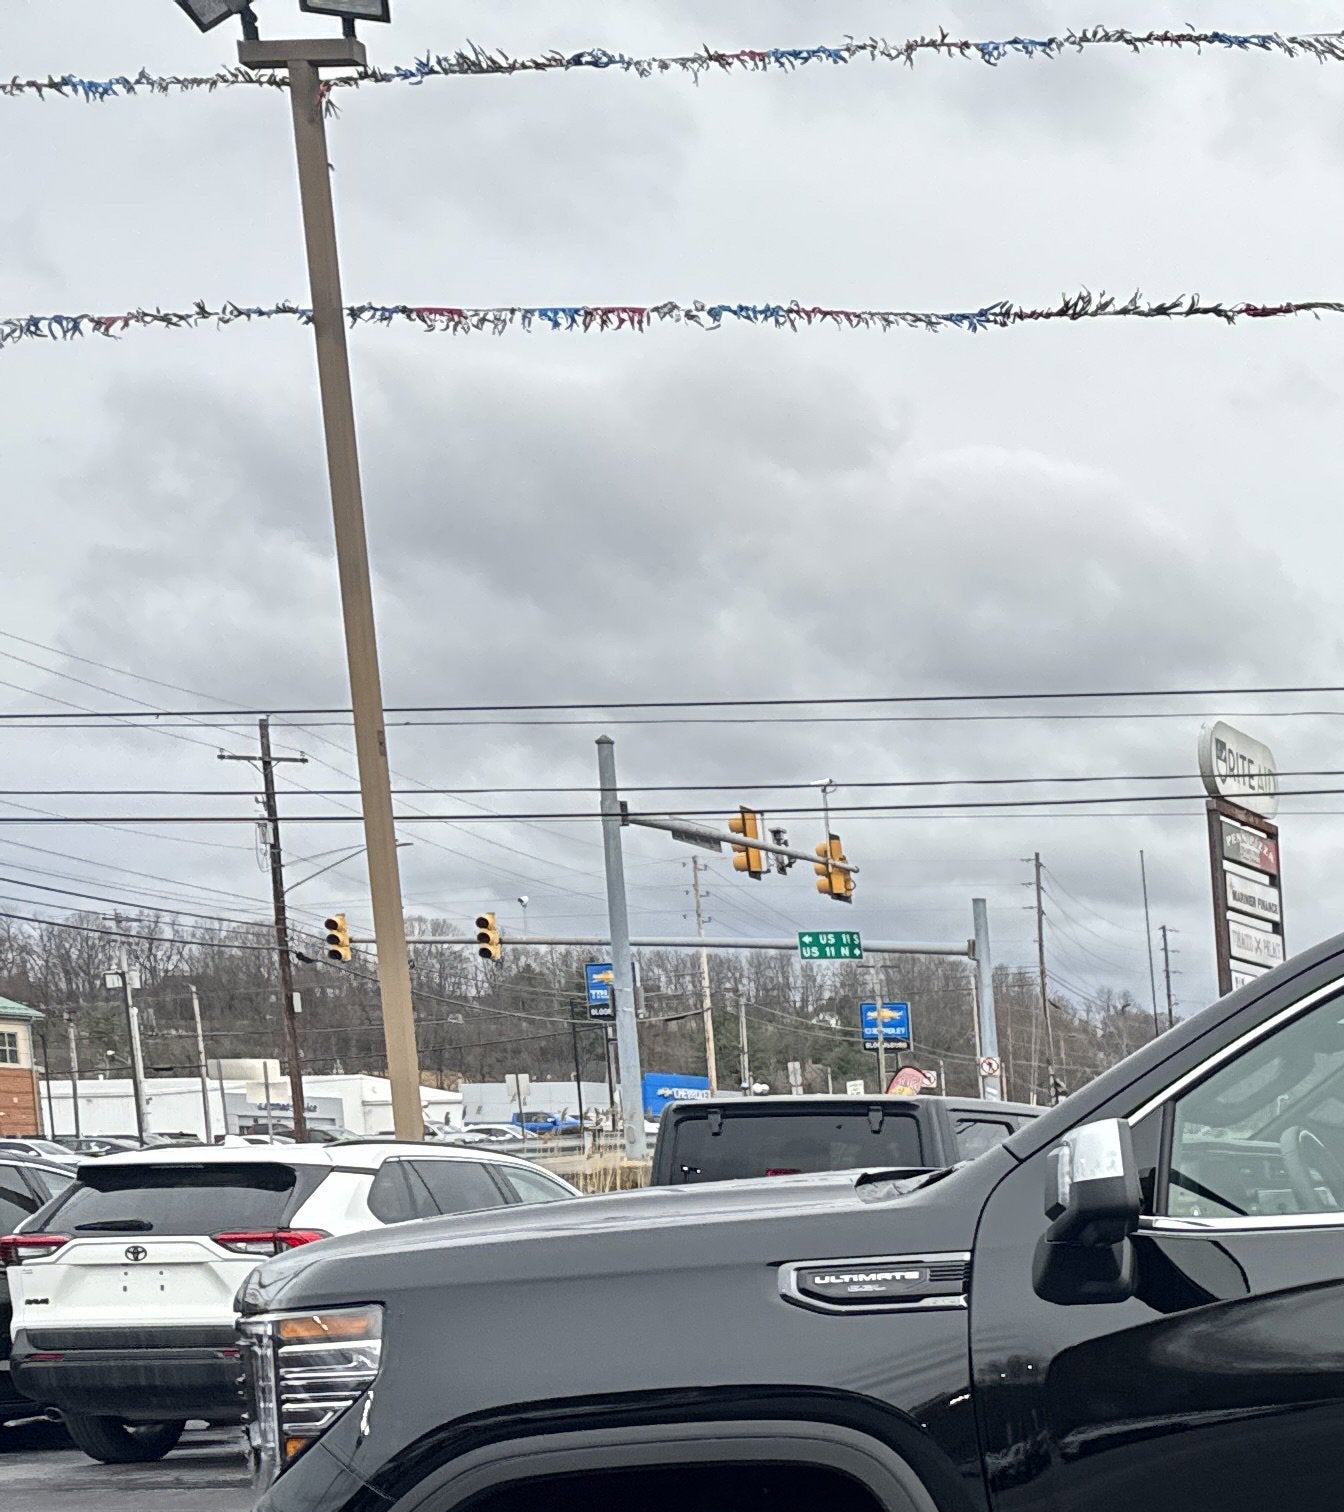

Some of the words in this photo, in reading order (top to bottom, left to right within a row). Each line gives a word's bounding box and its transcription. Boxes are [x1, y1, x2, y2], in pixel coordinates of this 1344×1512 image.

[1227, 748, 1256, 791] RITE
[819, 933, 836, 945] US
[841, 933, 851, 944] 11
[852, 933, 860, 945] S
[802, 946, 820, 957] US
[825, 946, 836, 957] 11
[840, 946, 850, 957] N
[814, 1270, 920, 1284] ULTIMATE
